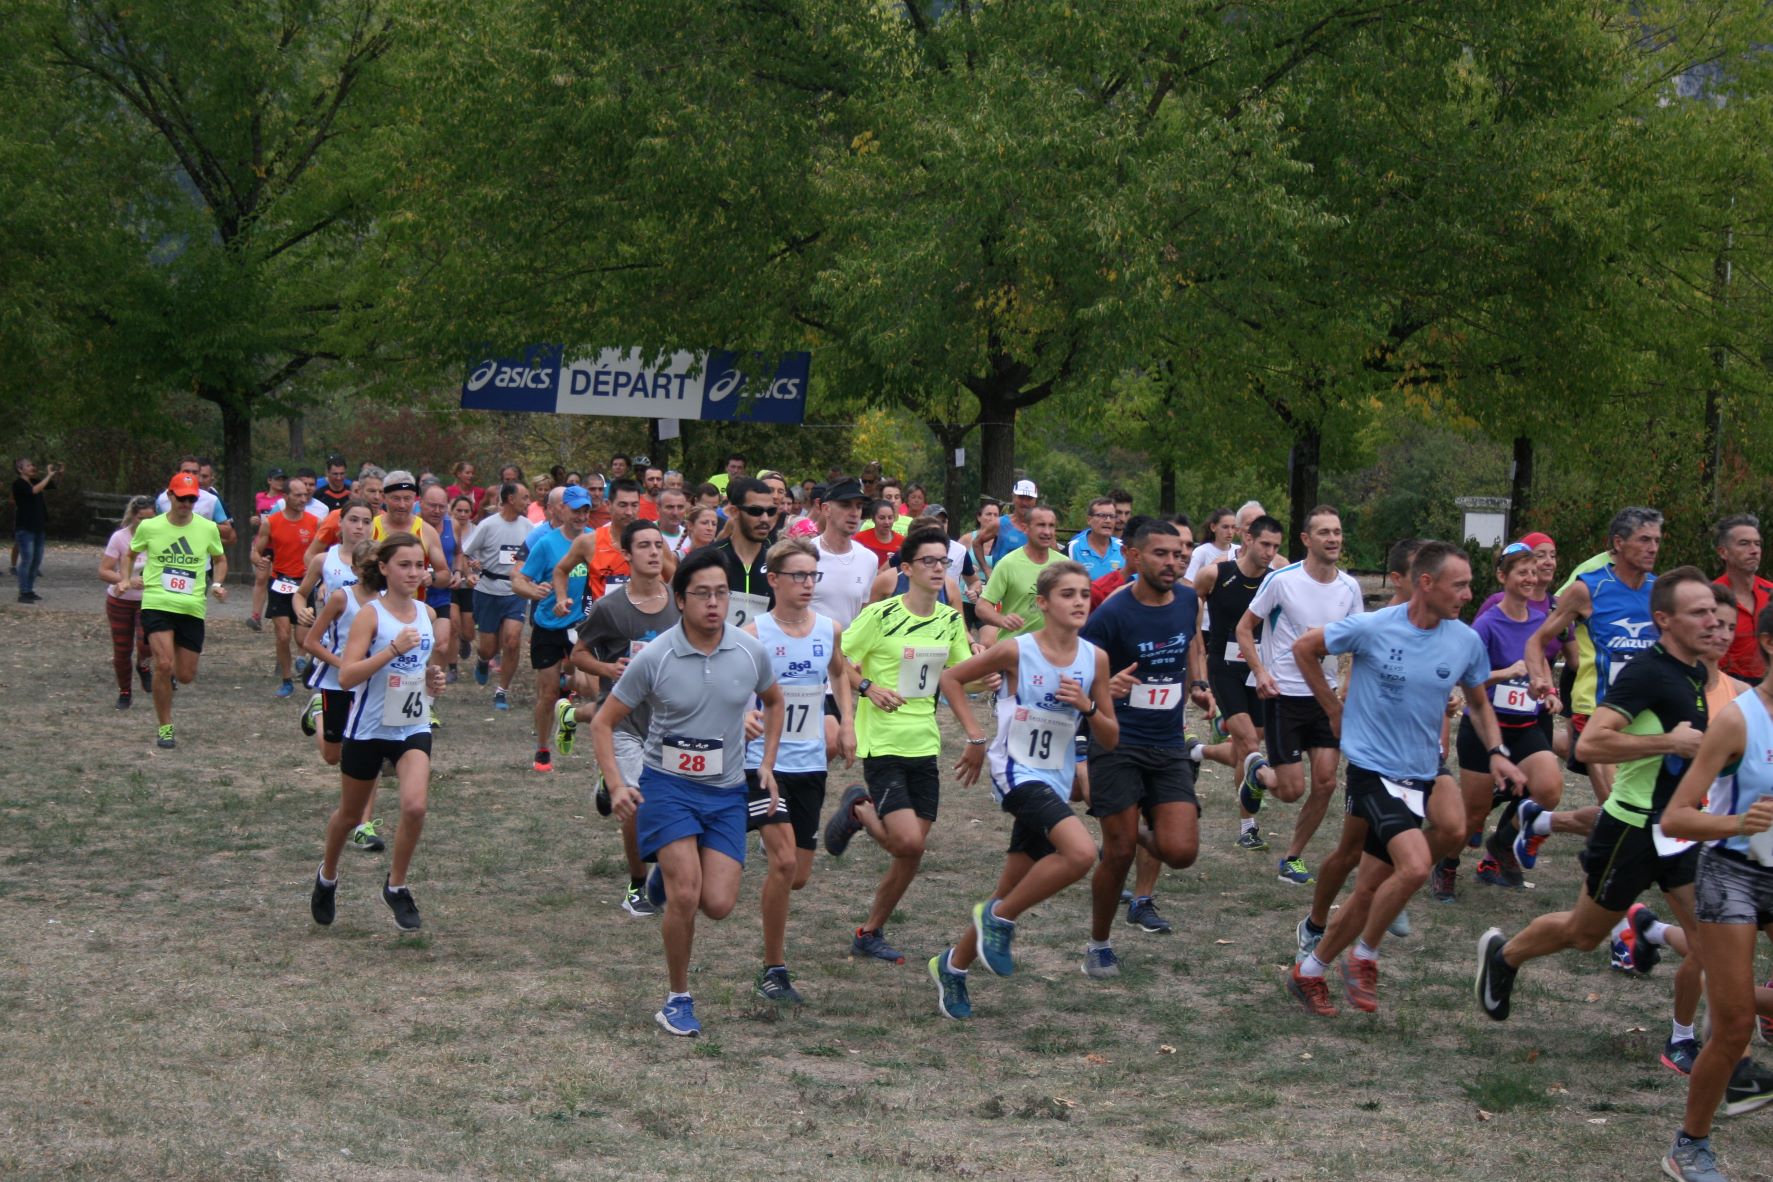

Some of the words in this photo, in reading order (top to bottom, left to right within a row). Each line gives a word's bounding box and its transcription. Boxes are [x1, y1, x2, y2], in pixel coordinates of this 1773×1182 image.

[569, 364, 692, 400] DÉPART
[157, 553, 200, 565] adidas
[170, 577, 186, 590] 68
[735, 609, 746, 627] 2
[788, 660, 812, 672] asa
[918, 663, 929, 691] 9
[401, 691, 423, 719] 45
[1147, 688, 1170, 706] 17
[1507, 690, 1526, 707] 61
[785, 703, 810, 733] 17
[1028, 728, 1053, 760] 19
[678, 753, 706, 773] 28
